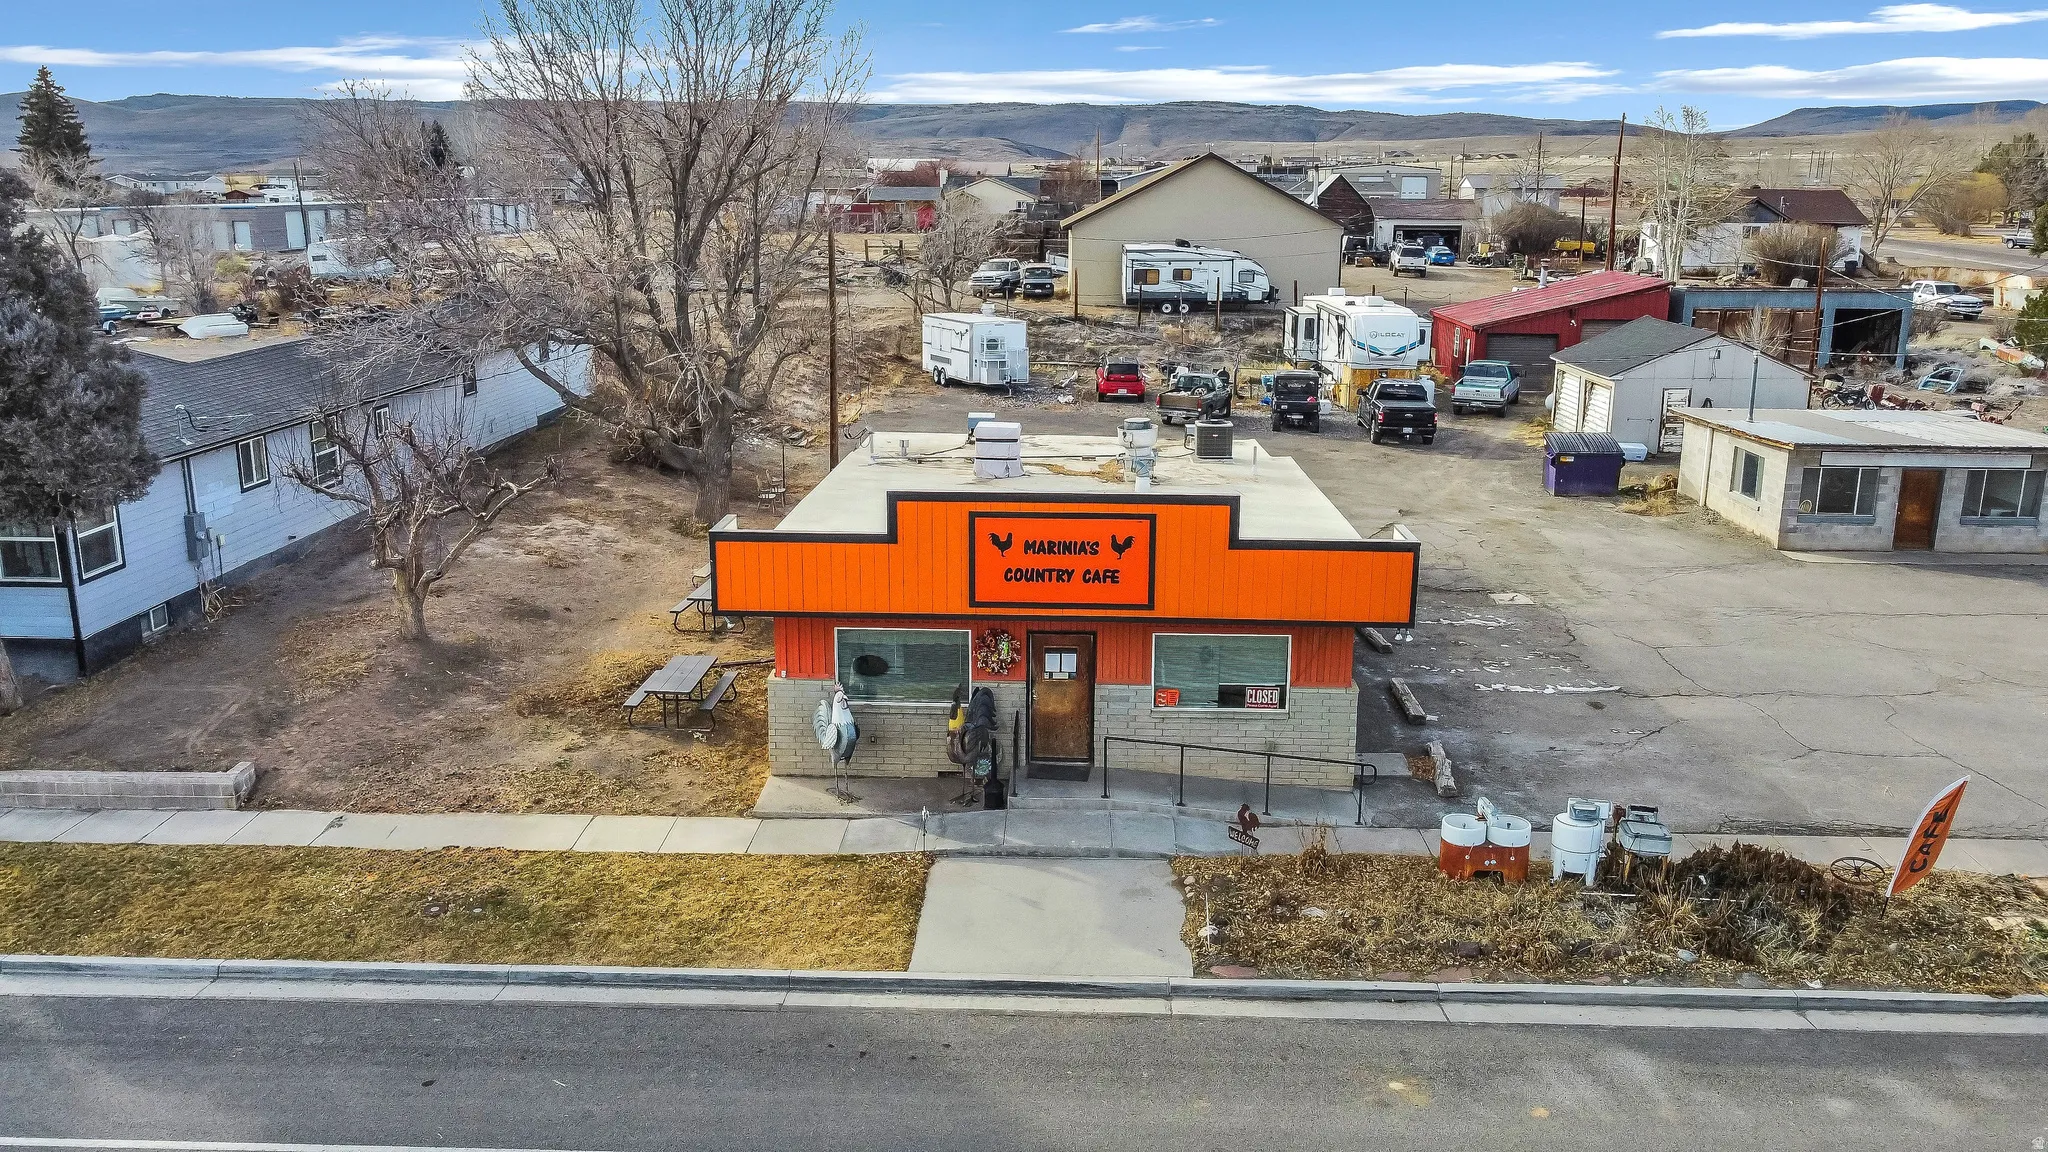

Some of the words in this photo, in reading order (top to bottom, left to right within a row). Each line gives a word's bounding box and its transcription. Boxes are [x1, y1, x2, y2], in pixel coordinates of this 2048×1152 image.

[1024, 539, 1100, 556] MARINIA'S
[1003, 567, 1075, 583] COUNTRY
[1082, 568, 1120, 584] CAFE
[1247, 689, 1278, 704] CLOSED
[1229, 830, 1258, 848] WELCOME
[1909, 808, 1949, 873] CAFE
